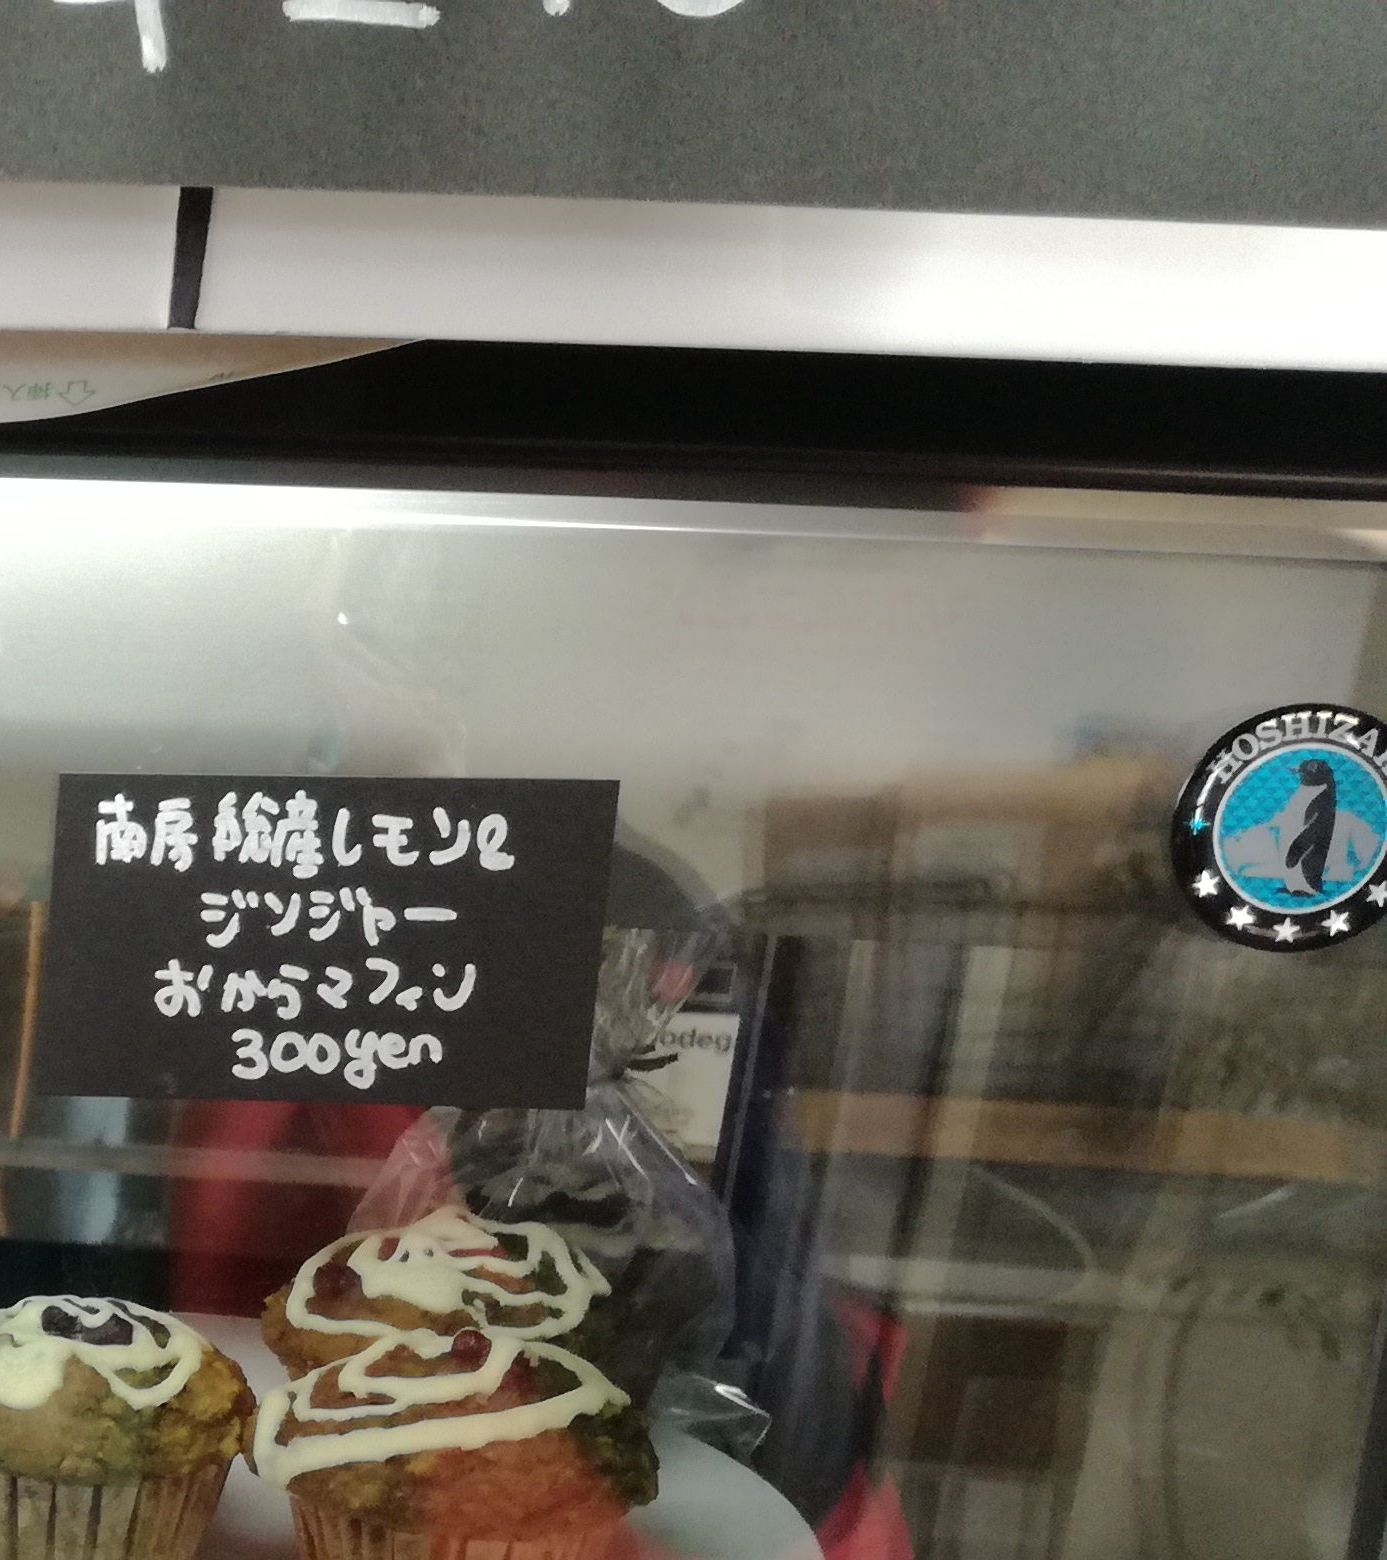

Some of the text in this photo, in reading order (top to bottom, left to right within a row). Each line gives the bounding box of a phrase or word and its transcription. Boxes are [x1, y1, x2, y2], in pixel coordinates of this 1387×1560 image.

[200, 887, 458, 947] ジンジャー
[153, 957, 476, 1019] おからマフィン
[231, 1028, 443, 1089] 300yen
